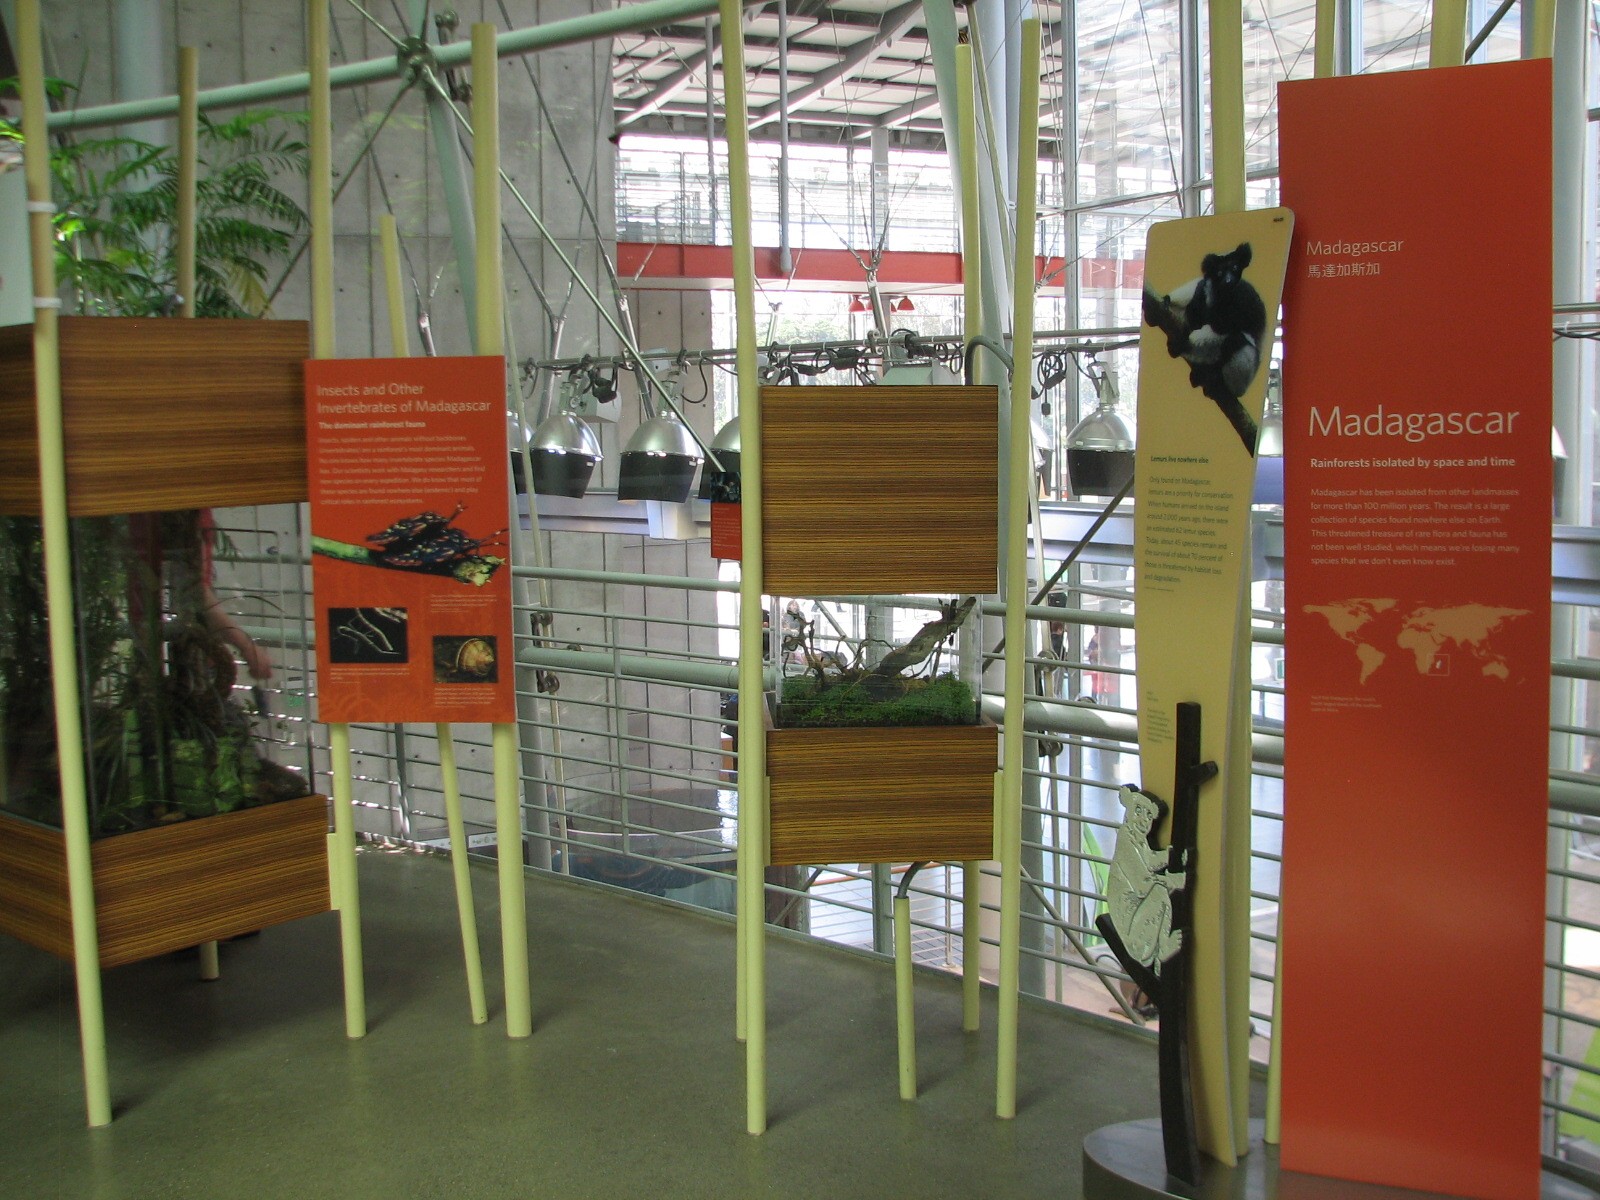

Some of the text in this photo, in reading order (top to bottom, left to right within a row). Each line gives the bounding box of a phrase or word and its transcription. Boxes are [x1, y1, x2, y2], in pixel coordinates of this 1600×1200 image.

[1306, 240, 1404, 256] Madagascar
[1308, 262, 1380, 278] 馬達加斯加
[317, 383, 424, 396] Insects and Other
[317, 401, 491, 414] Invertebrates of Madagascar
[1308, 404, 1520, 442] Madagascar
[1311, 457, 1515, 468] Rainforests isolated by space and time
[1311, 488, 1520, 497] Madagascar has been isolated from other landmasses
[1311, 502, 1321, 510] for
[1323, 502, 1343, 510] more
[1345, 502, 1362, 510] than
[1364, 502, 1378, 510] 100
[1380, 502, 1406, 510] million
[1409, 502, 1431, 511] years.
[1434, 502, 1448, 510] The
[1450, 502, 1472, 510] result
[1475, 502, 1481, 510] is
[1490, 502, 1510, 511] large
[1311, 516, 1502, 525] collection of species found nowhere else on Earth.
[1472, 544, 1495, 552] losing
[1497, 544, 1520, 552] many
[1311, 558, 1339, 566] species
